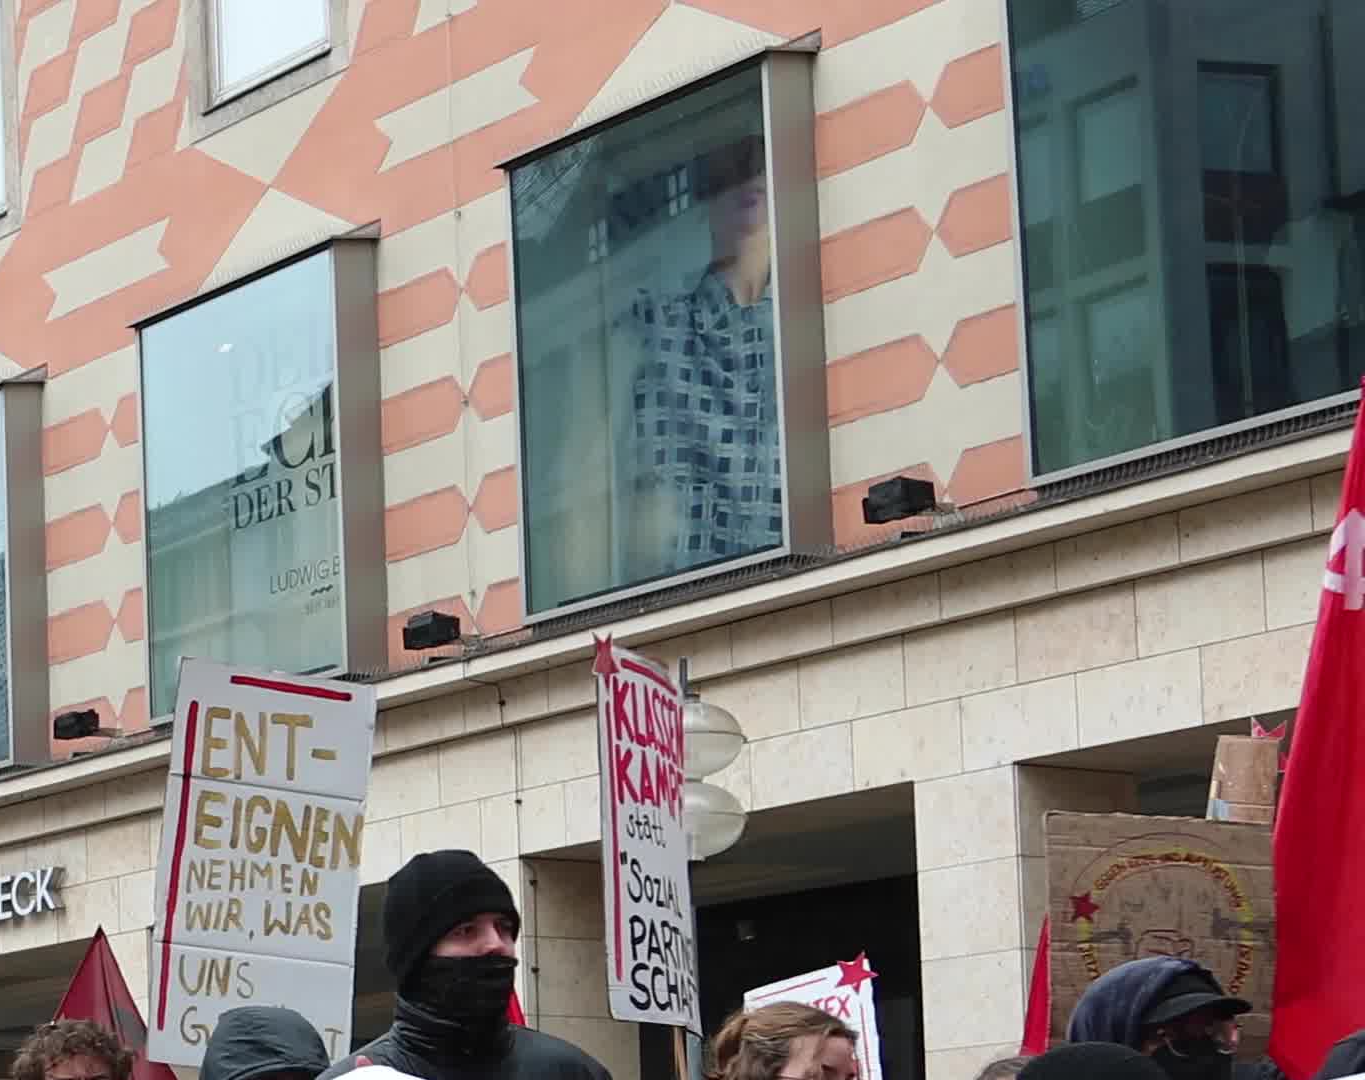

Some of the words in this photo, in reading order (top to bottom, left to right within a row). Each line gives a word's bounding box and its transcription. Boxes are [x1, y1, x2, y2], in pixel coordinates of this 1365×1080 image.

[232, 478, 297, 530] DER
[270, 559, 329, 595] LUDWIG
[200, 706, 336, 780] ENT-
[194, 790, 364, 870] EIGNEN
[186, 859, 318, 896] NEHMEN
[185, 899, 254, 940] WIR,
[263, 901, 333, 940] WAS
[179, 953, 254, 998] UNS
